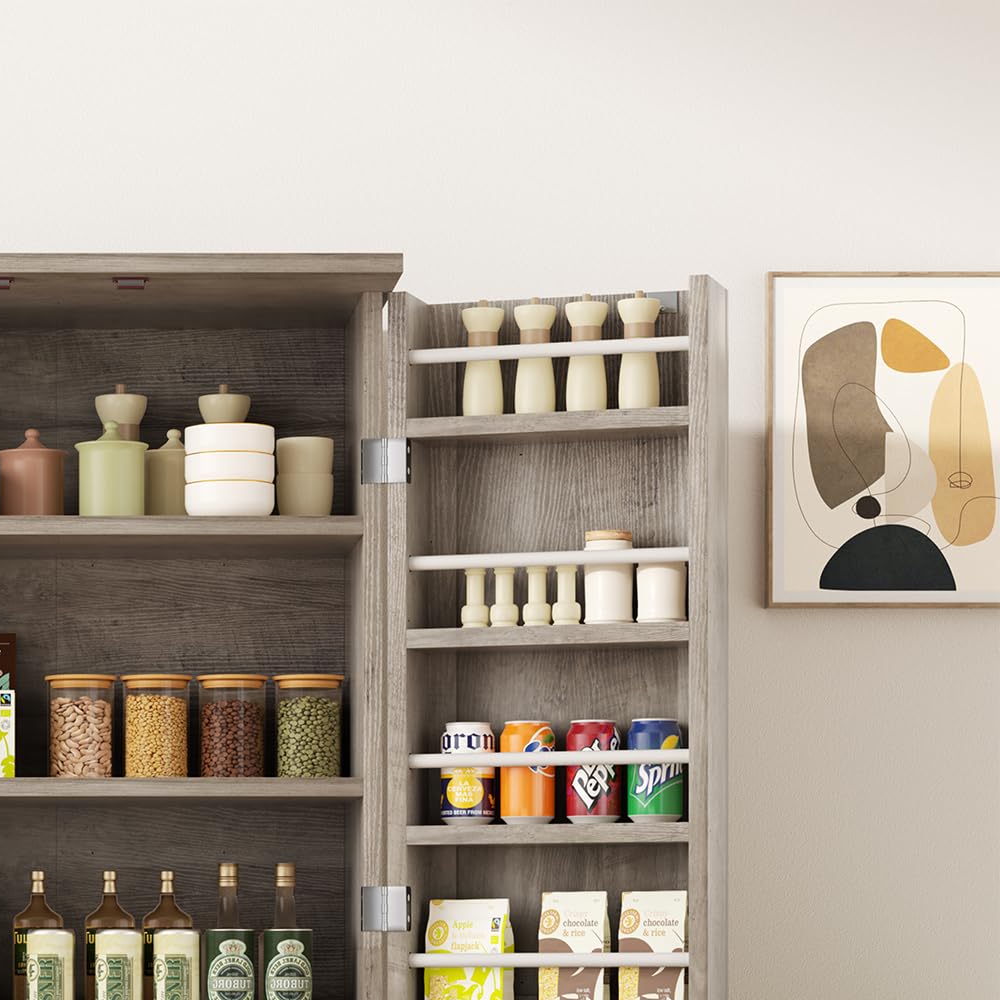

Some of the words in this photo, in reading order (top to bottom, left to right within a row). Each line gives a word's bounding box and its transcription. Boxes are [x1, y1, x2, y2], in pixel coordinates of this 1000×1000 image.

[563, 919, 598, 927] chocolate
[643, 919, 679, 927] chocolate
[571, 929, 586, 937] rice
[651, 929, 666, 937] rice
